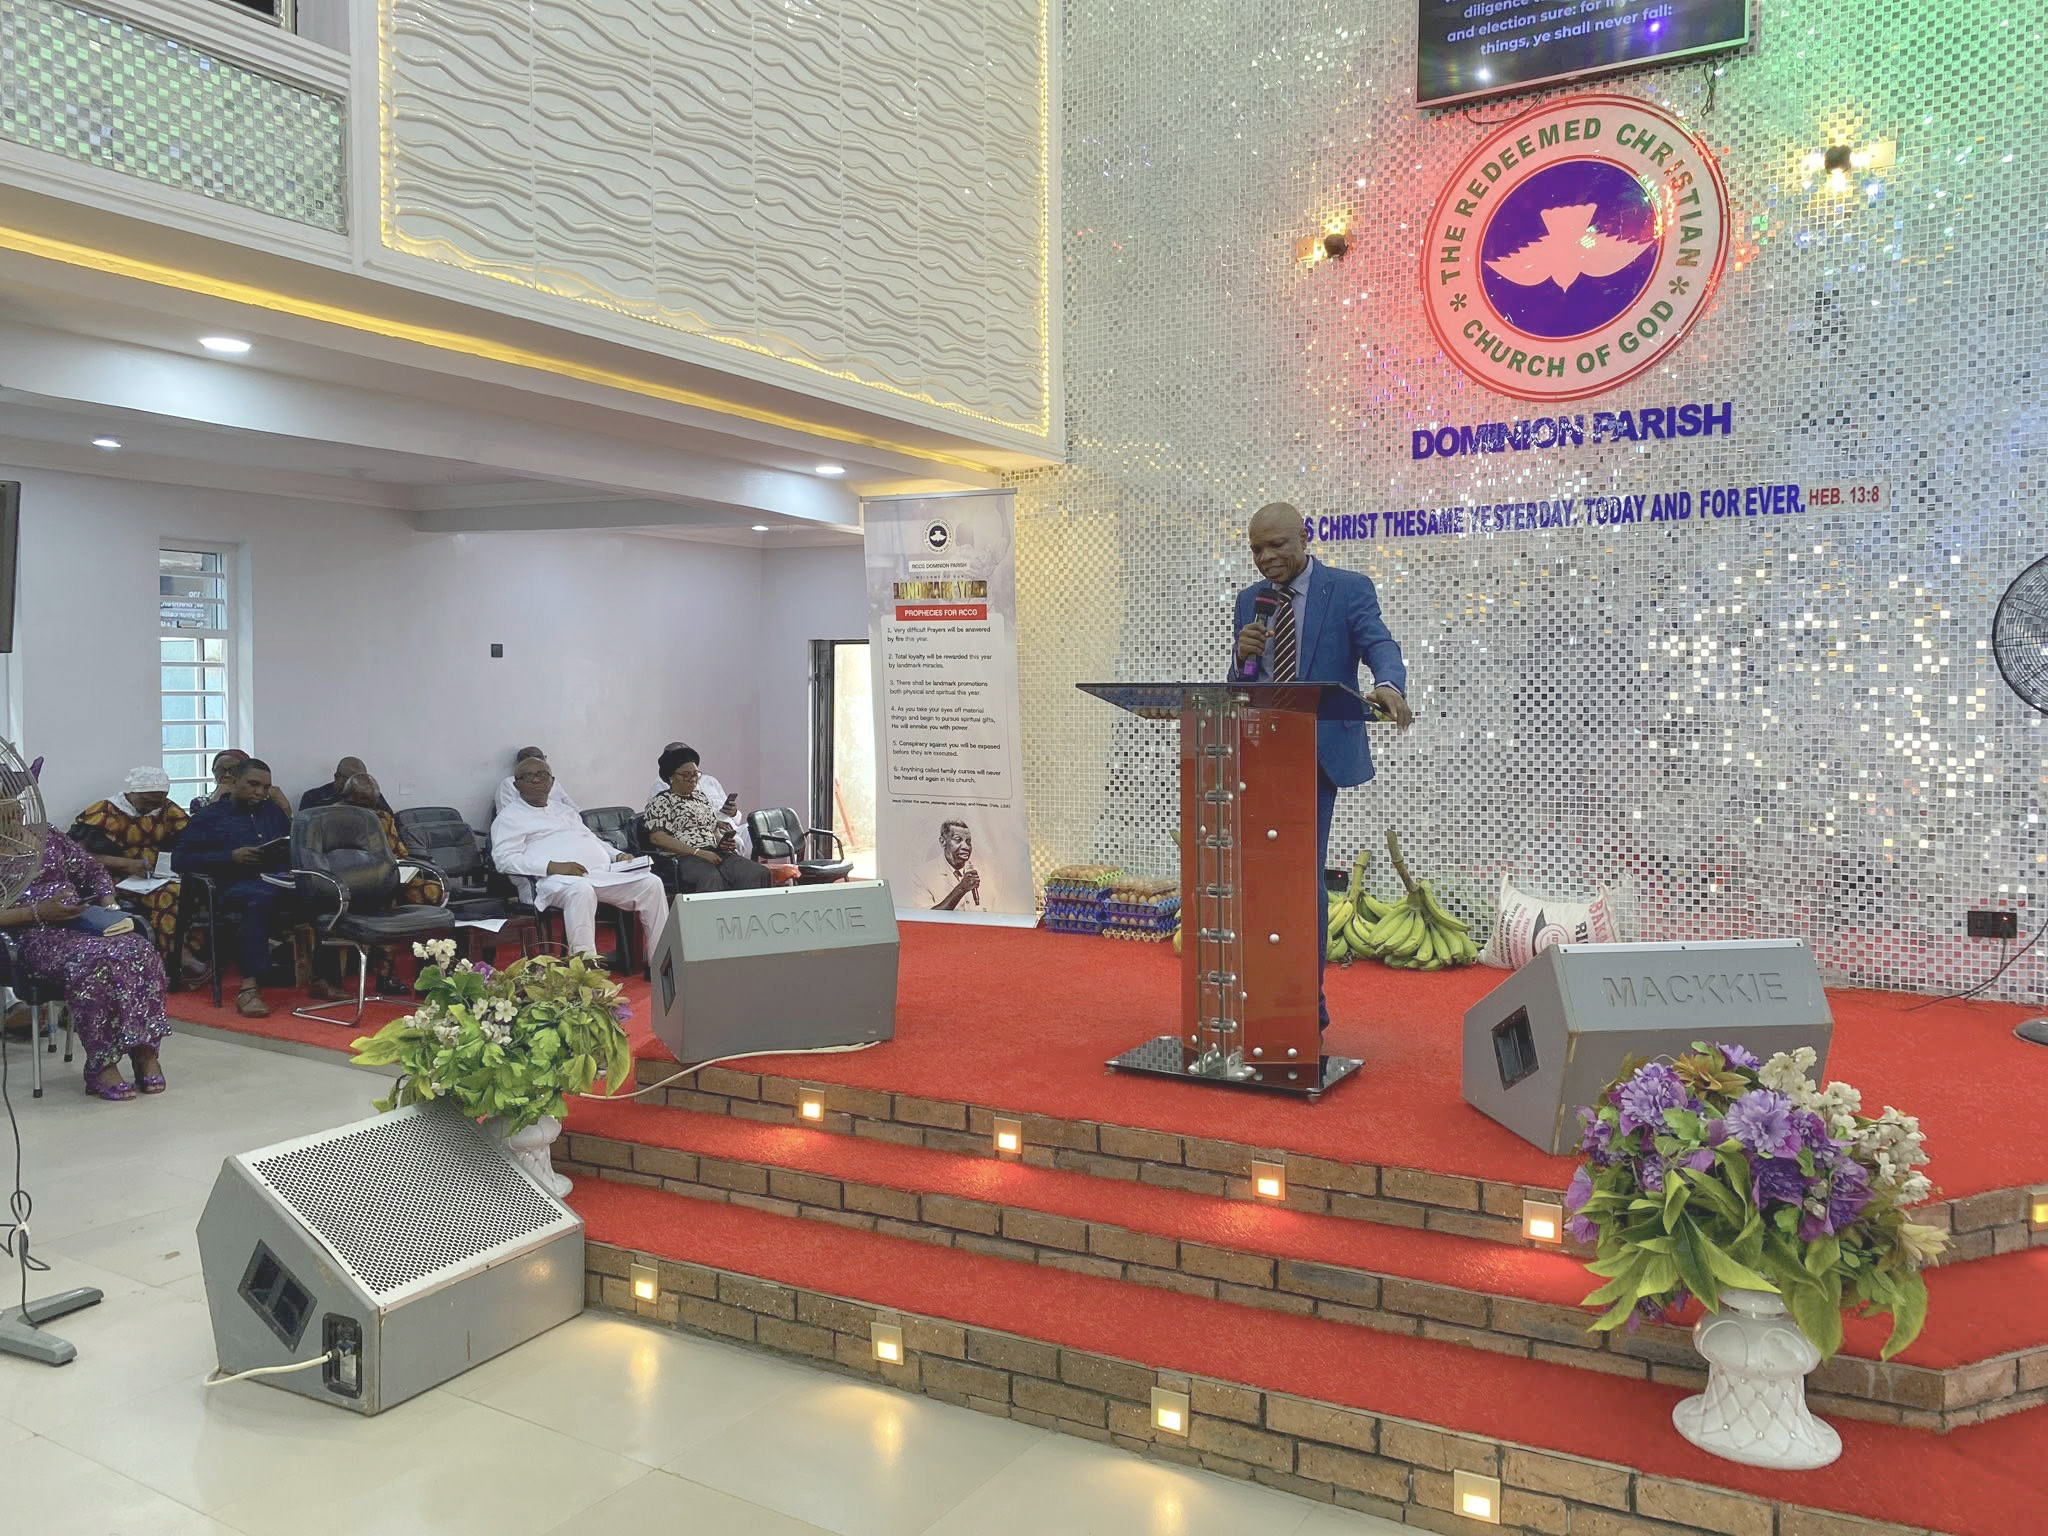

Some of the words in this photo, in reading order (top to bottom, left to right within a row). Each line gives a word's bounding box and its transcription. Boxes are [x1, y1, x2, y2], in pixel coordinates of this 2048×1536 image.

[1447, 25, 1475, 42] and
[1479, 15, 1537, 36] election
[1540, 6, 1577, 22] sure:
[1580, 0, 1601, 13] for
[1480, 37, 1530, 55] things,
[1533, 32, 1551, 47] ye
[1554, 20, 1590, 40] shall
[1595, 13, 1639, 31] never
[1642, 4, 1672, 21] fall:
[1440, 225, 1467, 285] THE
[1455, 117, 1601, 218] REDEEMED
[1615, 123, 1703, 267] CHRISTIAN
[1462, 319, 1566, 377] CHURCH
[1576, 344, 1612, 374] OF
[1618, 300, 1674, 353] GOD
[1412, 414, 1585, 460] DOMINION
[1592, 402, 1732, 444] PARISH
[1318, 512, 1378, 541] CHRIST
[1585, 494, 1646, 526] TODAY
[1649, 491, 1691, 522] AND
[1808, 487, 1845, 506] HEB.
[1850, 485, 1880, 504] 13:8
[716, 906, 866, 943] MACKKIE
[1575, 920, 1589, 943] RI
[1602, 972, 1788, 1007] MACKKIE
